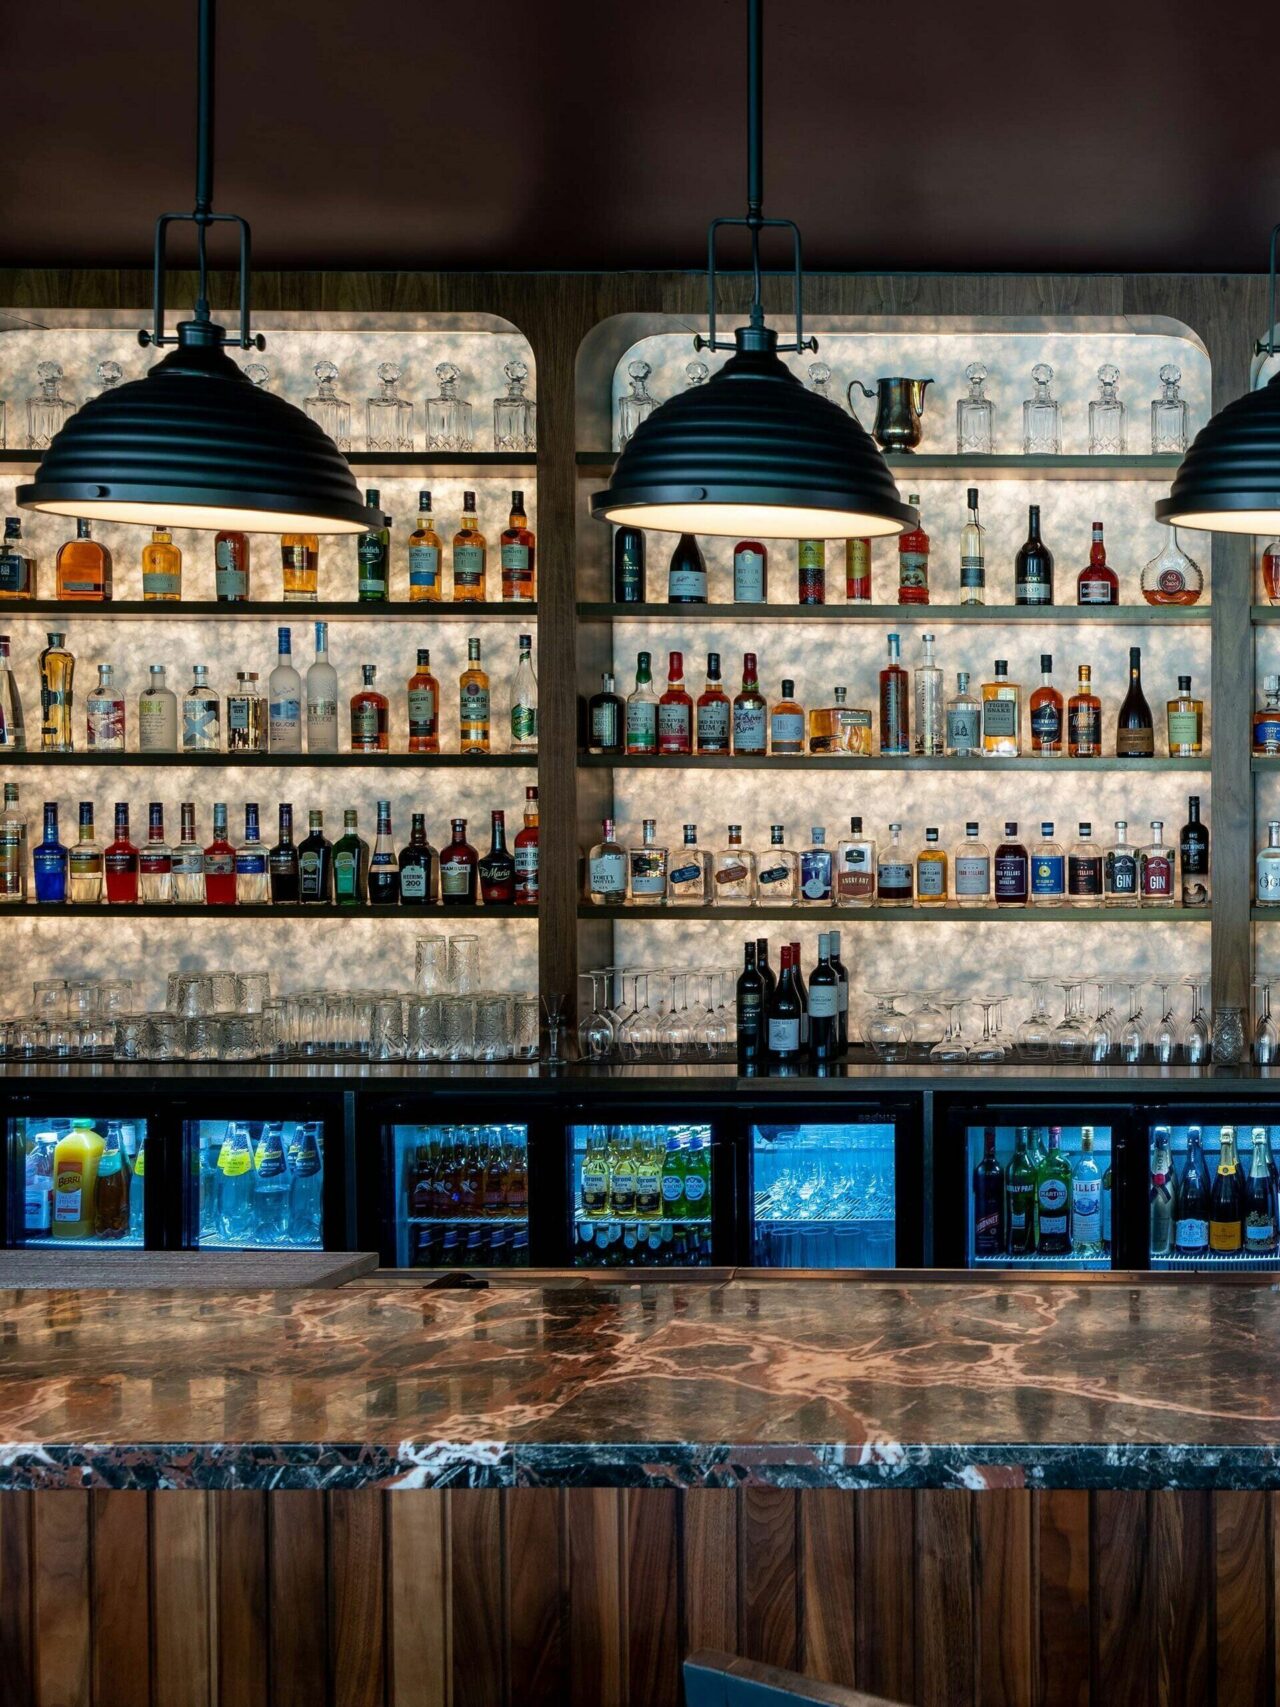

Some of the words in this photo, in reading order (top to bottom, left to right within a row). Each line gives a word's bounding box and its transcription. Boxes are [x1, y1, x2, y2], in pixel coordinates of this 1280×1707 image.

[491, 866, 511, 880] Maria
[1116, 874, 1132, 888] GIN
[1150, 875, 1166, 889] GIN
[58, 1176, 81, 1188] BERRI
[1073, 1184, 1100, 1192] LILLET
